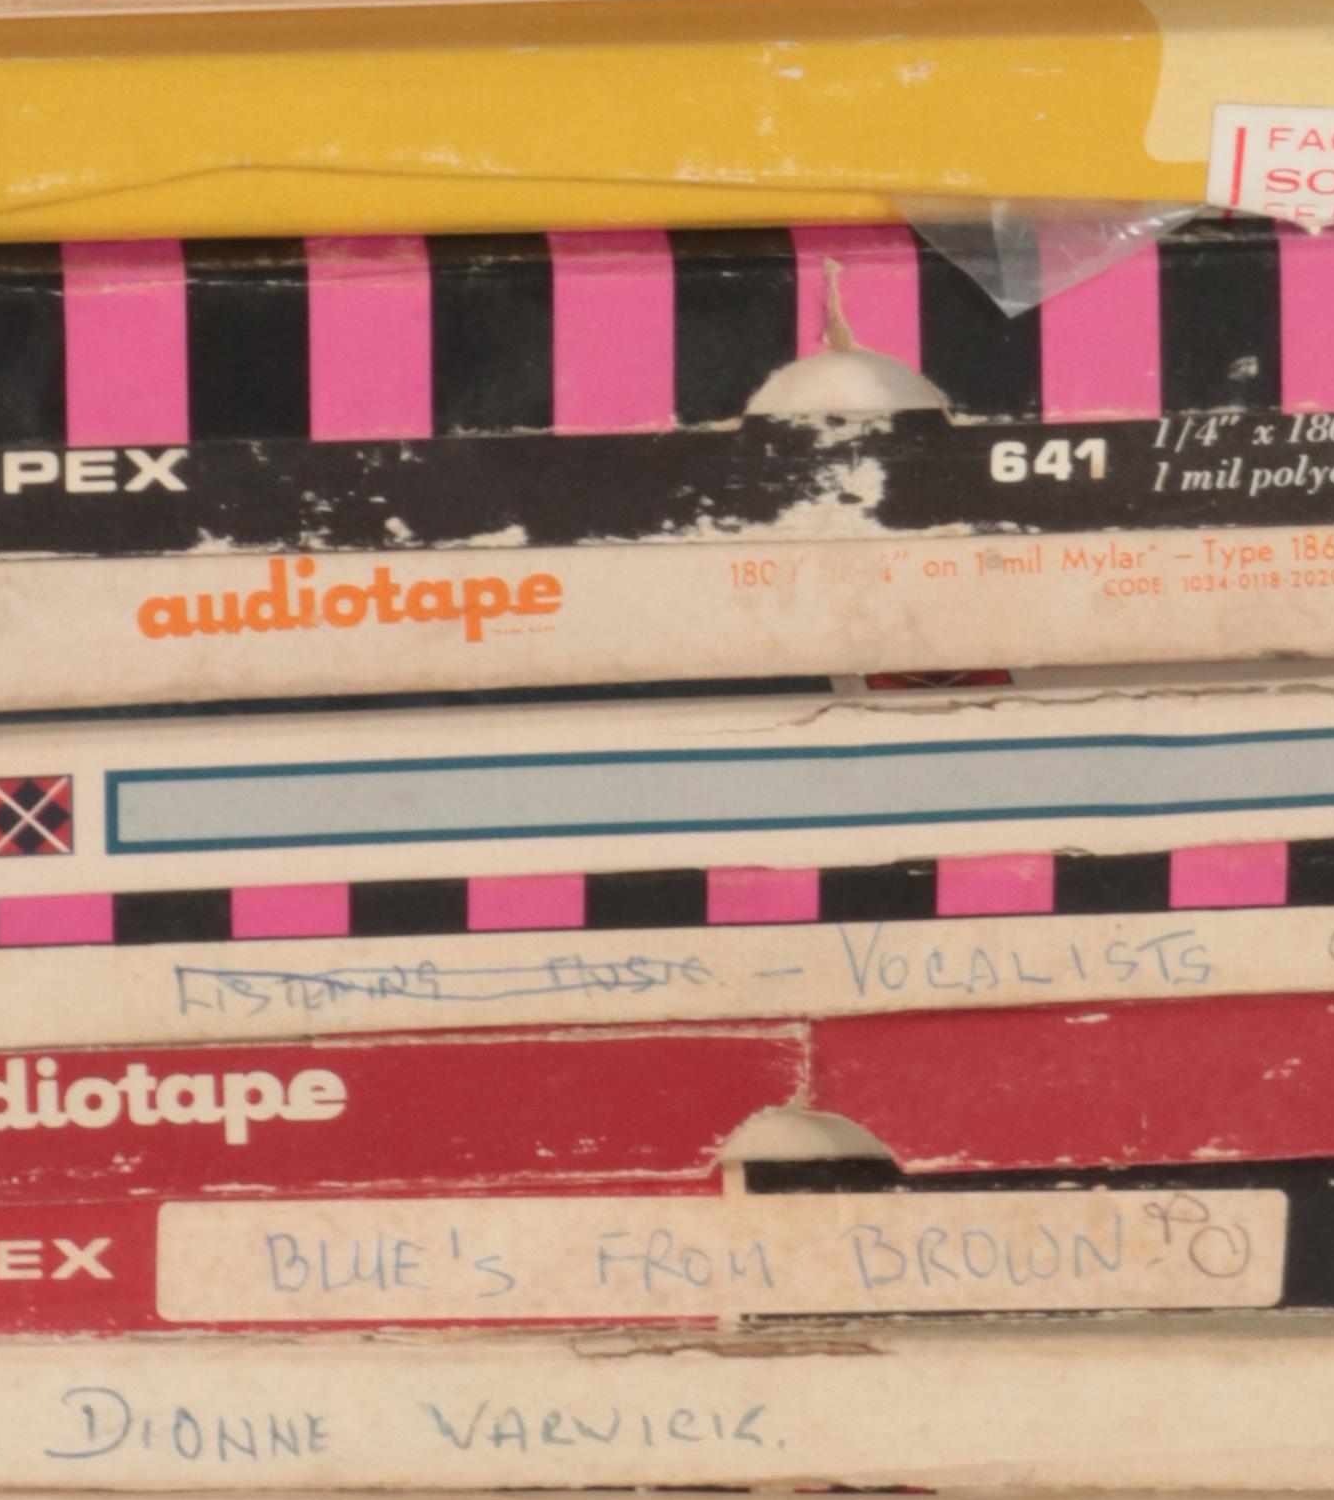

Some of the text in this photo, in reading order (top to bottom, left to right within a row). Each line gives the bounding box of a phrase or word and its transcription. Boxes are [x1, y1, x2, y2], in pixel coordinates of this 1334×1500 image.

[1251, 424, 1276, 446] x
[989, 438, 1108, 483] 641
[1181, 456, 1243, 491] mil
[924, 558, 959, 579] on
[1001, 546, 1043, 576] mil
[1201, 538, 1273, 570] Type
[137, 554, 563, 643] audiotape
[835, 922, 1213, 999] VOCALISTS
[596, 1228, 775, 1291] FROM
[843, 1214, 1123, 1290] BROWN
